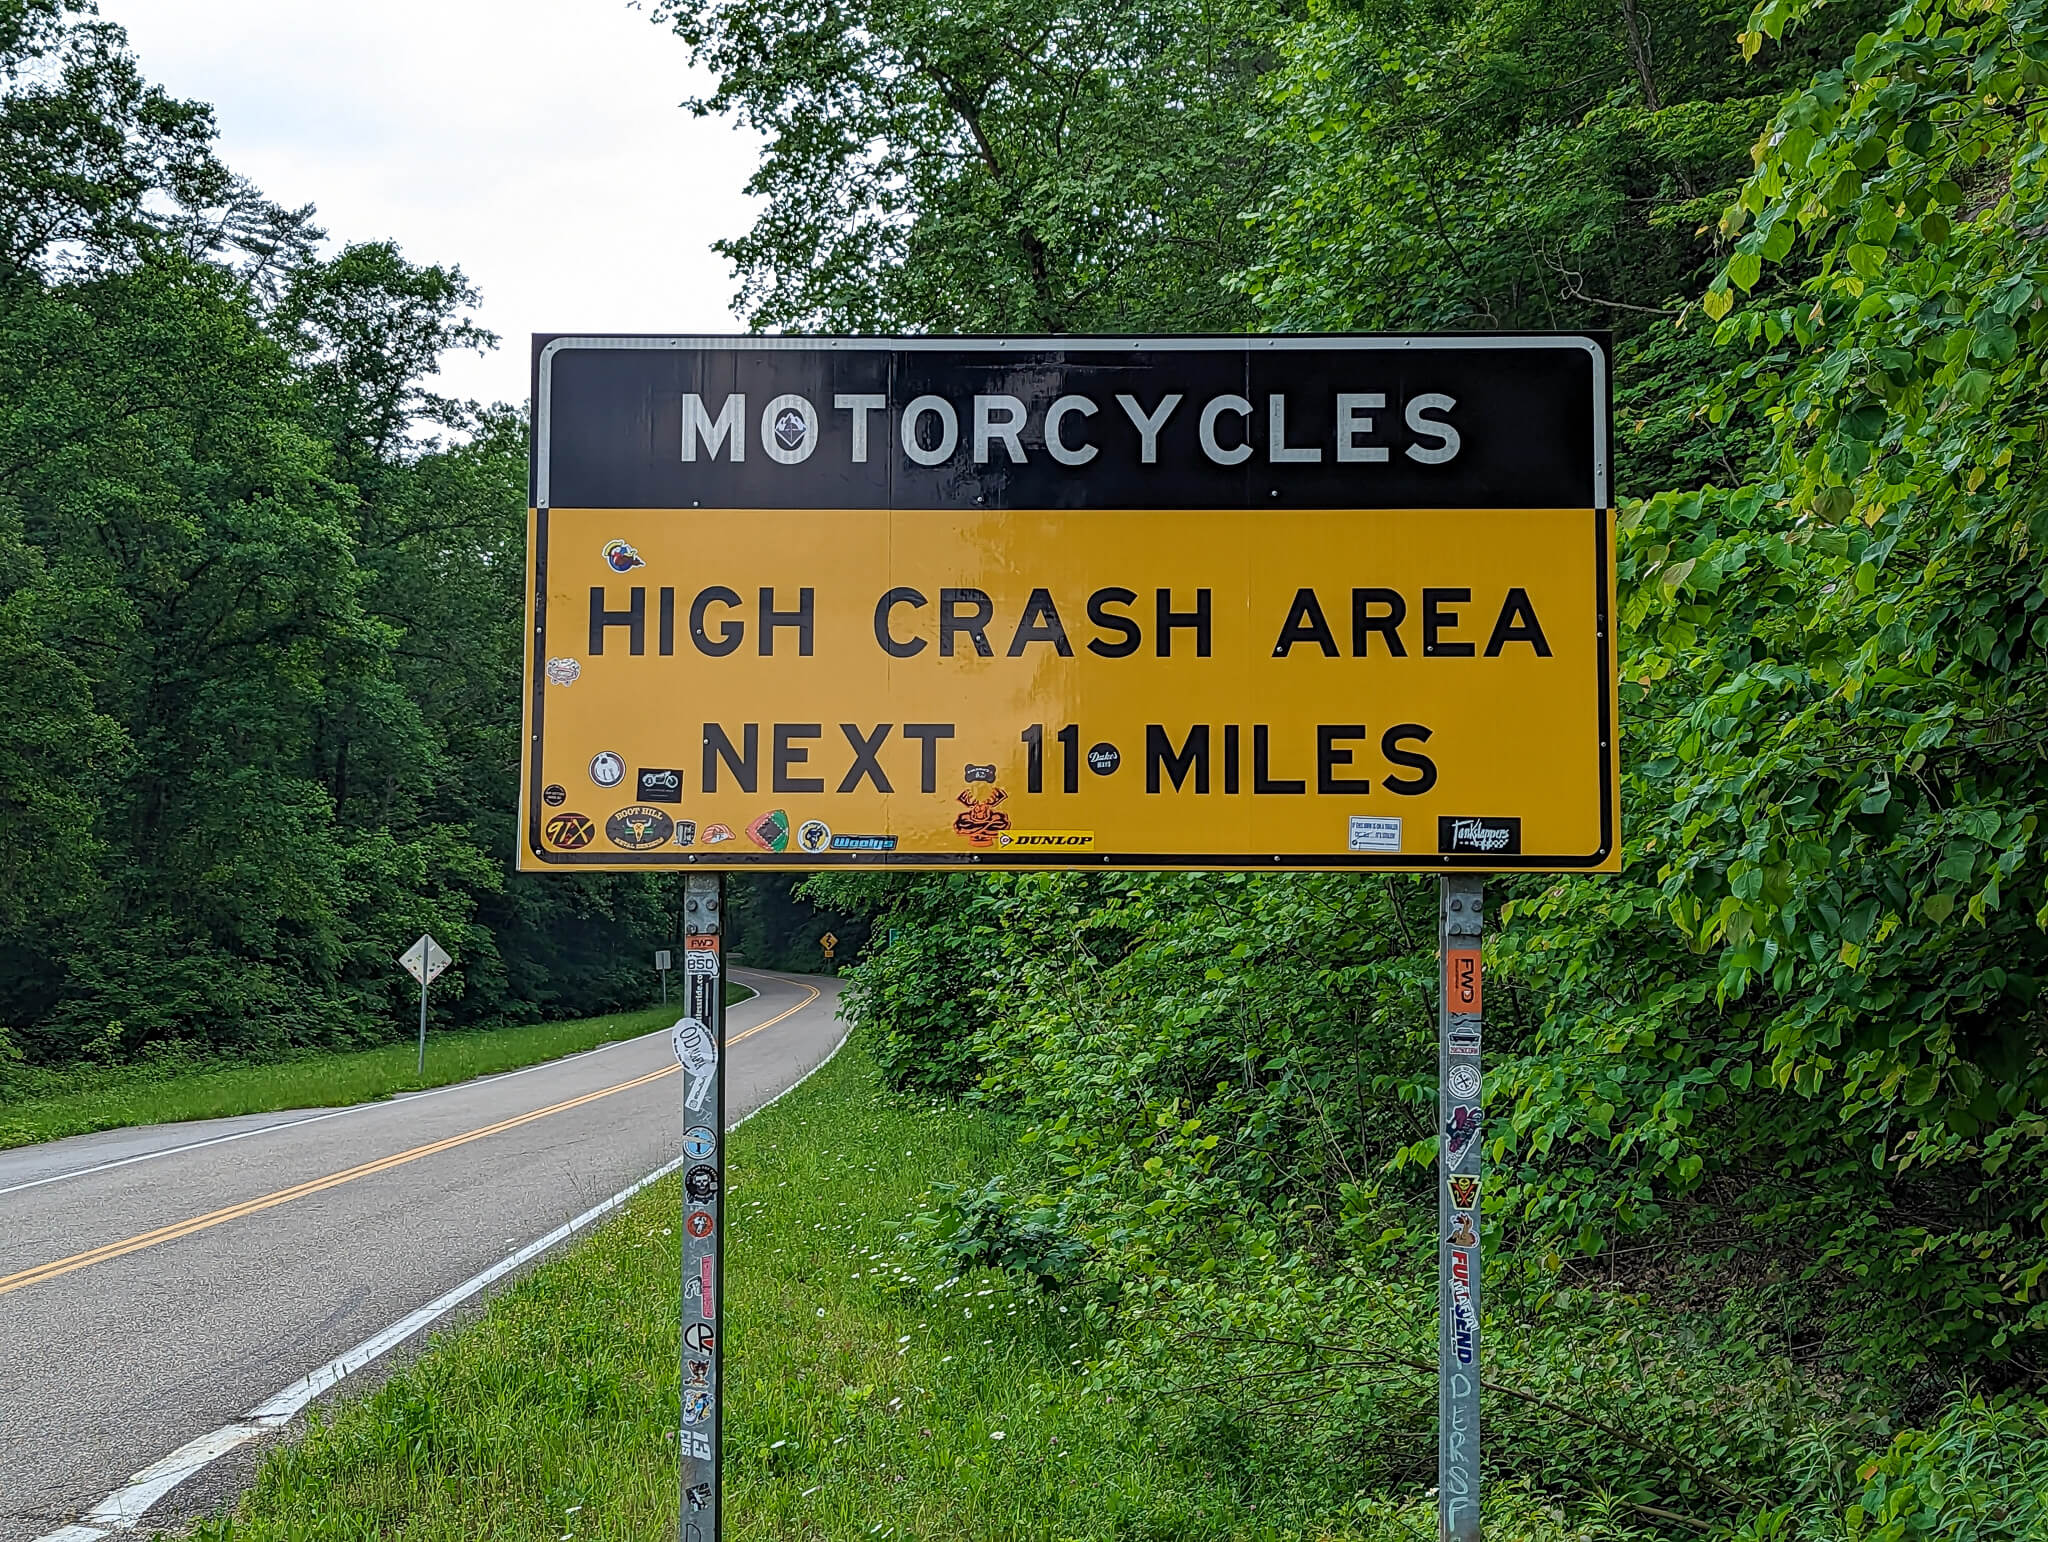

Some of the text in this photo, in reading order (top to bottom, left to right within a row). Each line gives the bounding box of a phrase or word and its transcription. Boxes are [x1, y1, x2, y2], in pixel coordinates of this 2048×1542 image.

[682, 393, 1461, 466] MOTORCYCLES
[588, 586, 1553, 658] HIGH CRASH AREA
[702, 723, 1438, 796] NEXT 11 MILES
[1015, 836, 1093, 845] DUNLOP
[691, 939, 714, 948] FWD
[1461, 958, 1474, 1003] FWD
